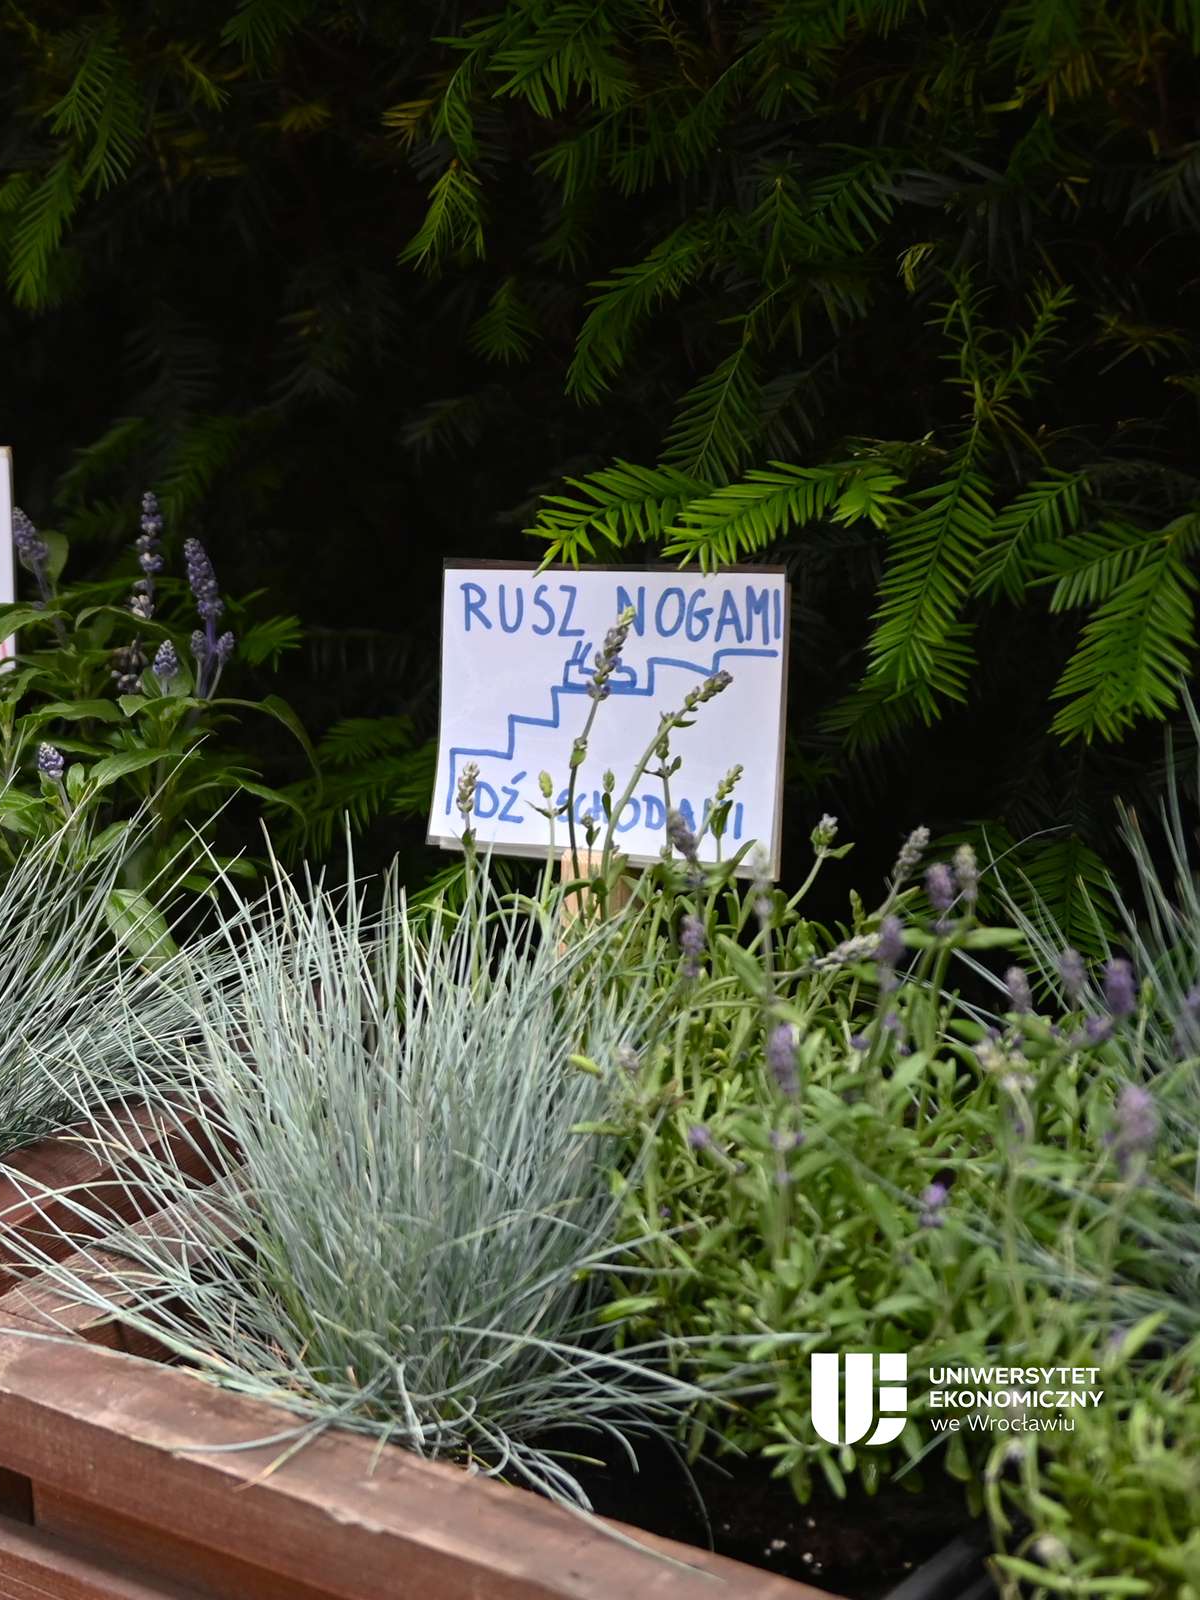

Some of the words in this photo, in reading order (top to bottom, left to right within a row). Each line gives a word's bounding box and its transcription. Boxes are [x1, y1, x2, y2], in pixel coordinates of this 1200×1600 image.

[460, 582, 585, 637] RUSZ
[616, 585, 781, 645] NOGAMI
[461, 770, 527, 824] DŹ
